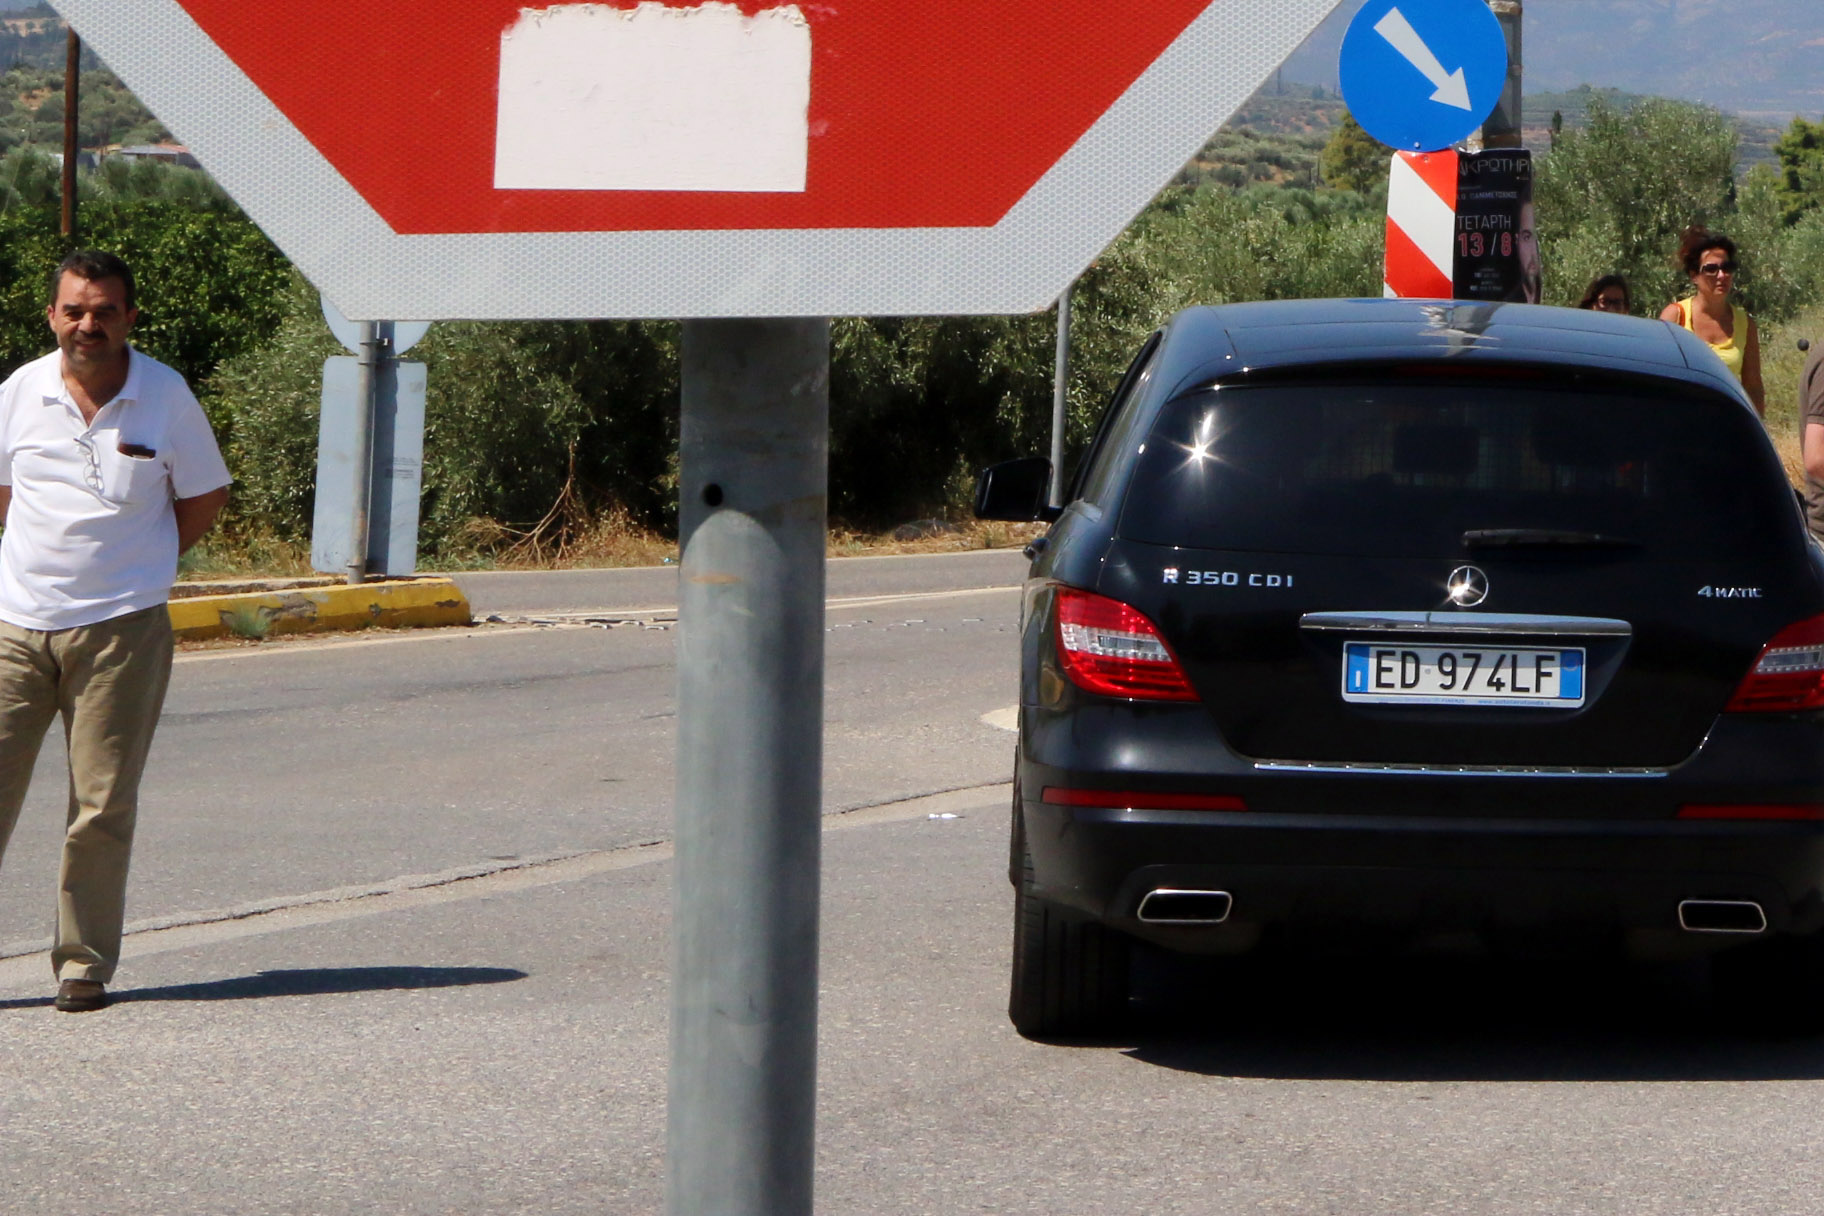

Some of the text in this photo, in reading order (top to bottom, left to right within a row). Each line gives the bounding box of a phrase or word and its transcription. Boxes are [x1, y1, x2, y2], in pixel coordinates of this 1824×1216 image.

[1163, 568, 1293, 588] R 350 CDI
[1375, 649, 1420, 689] ED
[1438, 652, 1556, 694] 974LF
